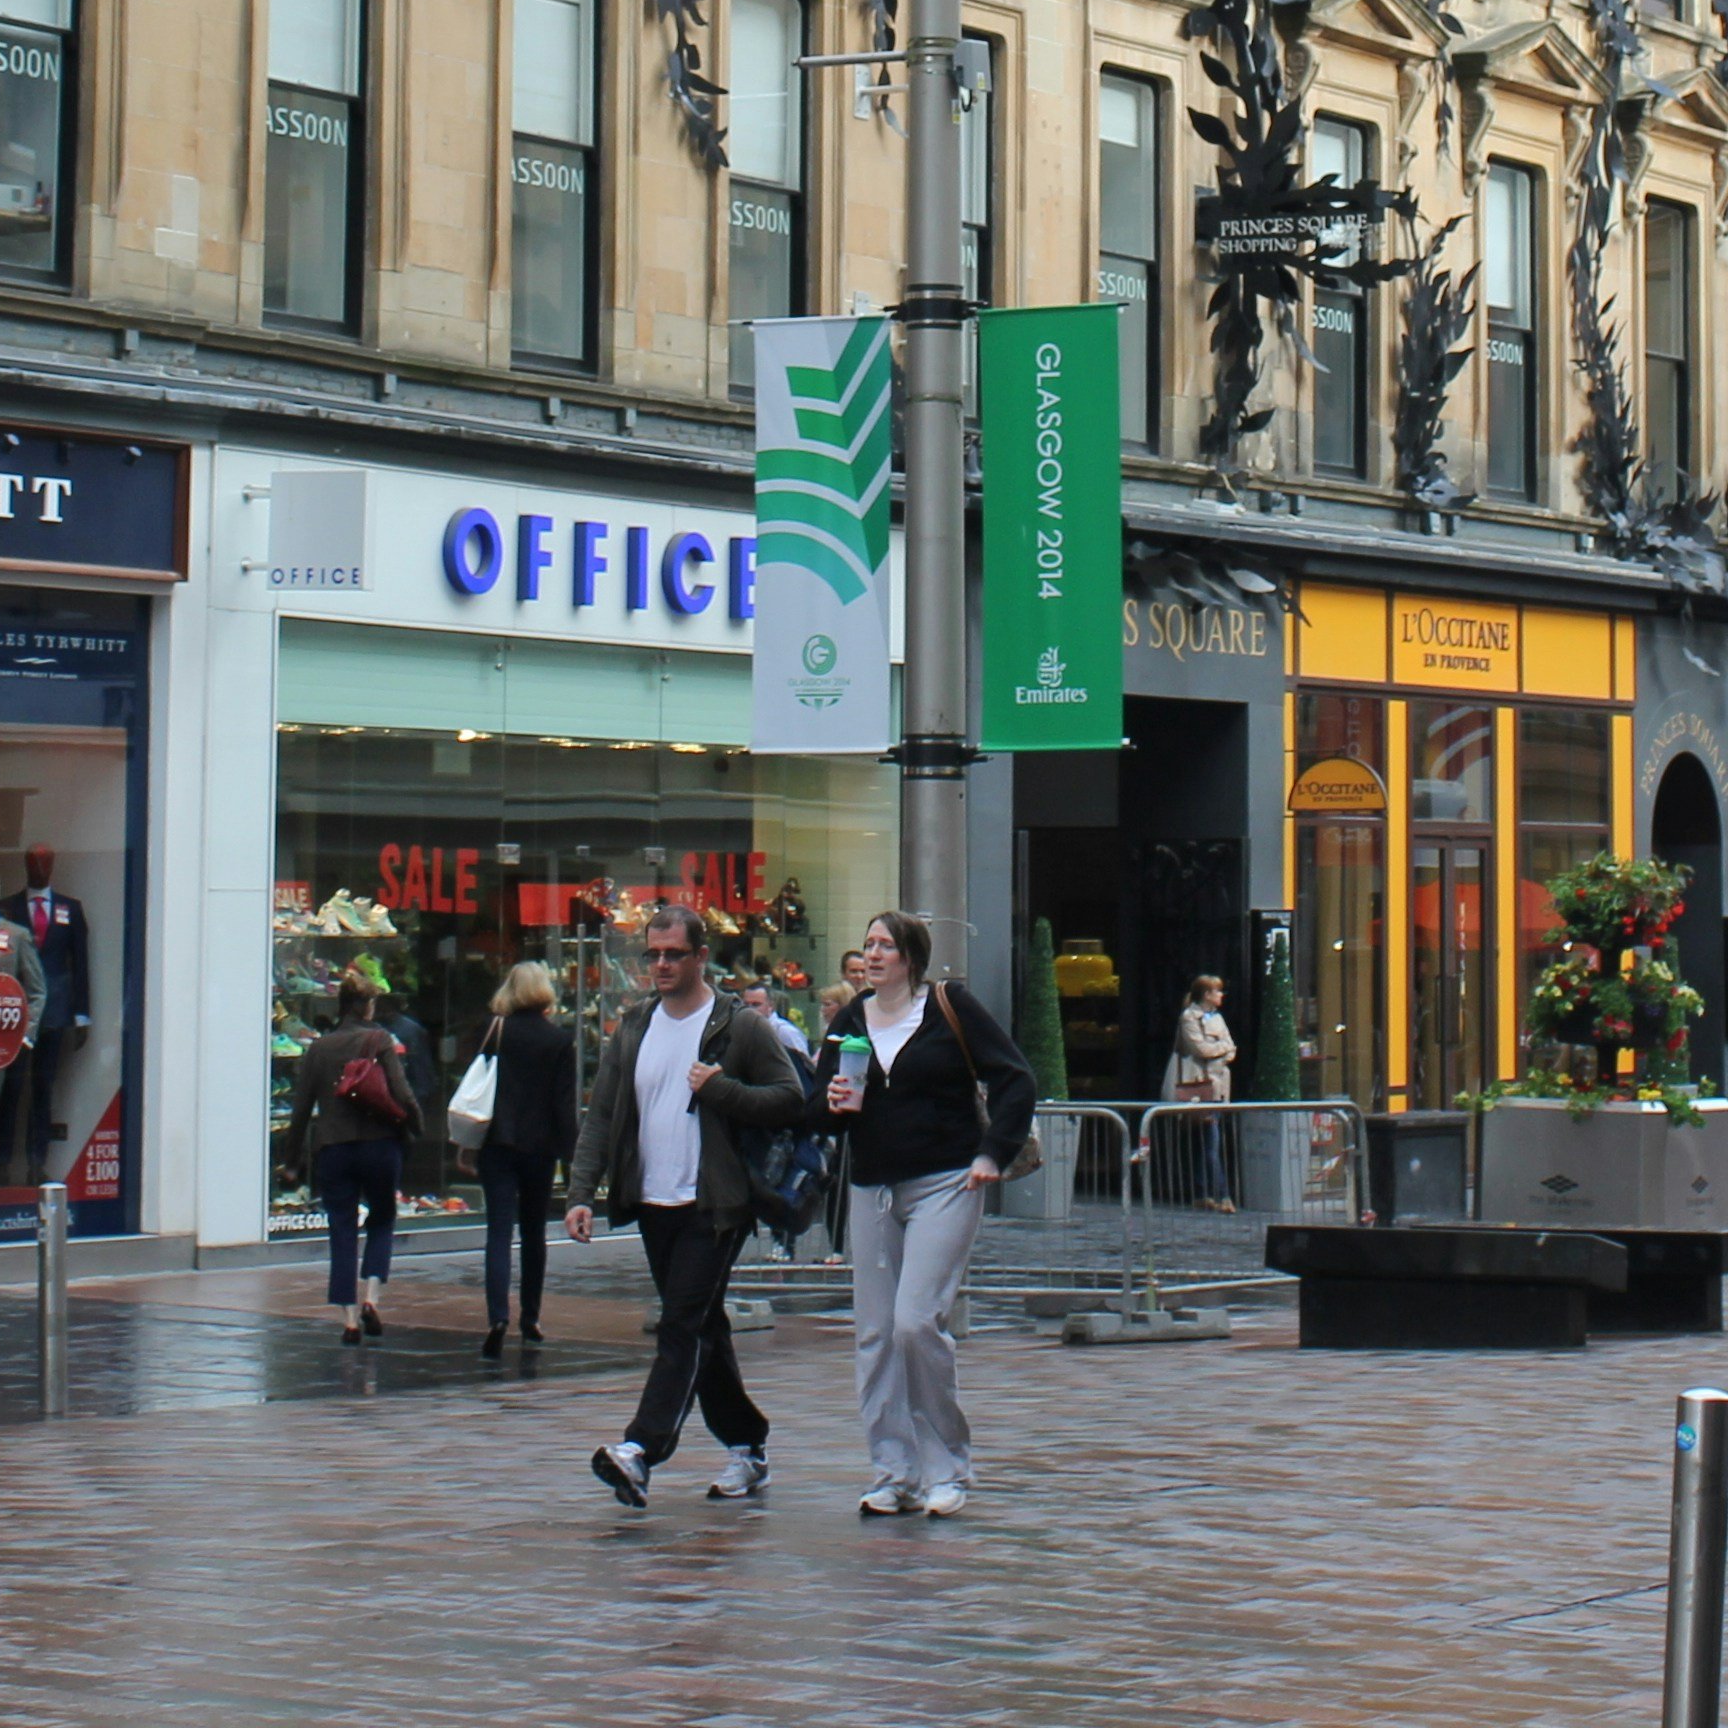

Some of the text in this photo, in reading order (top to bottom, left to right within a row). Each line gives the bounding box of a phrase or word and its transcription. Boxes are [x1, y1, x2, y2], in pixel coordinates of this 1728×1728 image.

[1220, 212, 1369, 238] PRINCES SQUARE
[1218, 237, 1298, 255] SHOPPING
[1035, 342, 1063, 600] GLASGOW 2014
[443, 506, 756, 621] OFFICE
[271, 566, 361, 586] OFFICE
[1148, 601, 1269, 663] SQUARE
[1401, 607, 1511, 652] L'OCCITANE
[33, 634, 128, 653] TYRWHITT
[1423, 653, 1491, 672] EN PROVENCE
[1015, 685, 1088, 705] Emirates
[1297, 781, 1379, 796] L'OCCITANE
[377, 842, 480, 915] SALE
[680, 851, 767, 915] SALE
[274, 886, 309, 911] SALE
[86, 1143, 119, 1159] 4 FOR
[86, 1160, 120, 1182] £100
